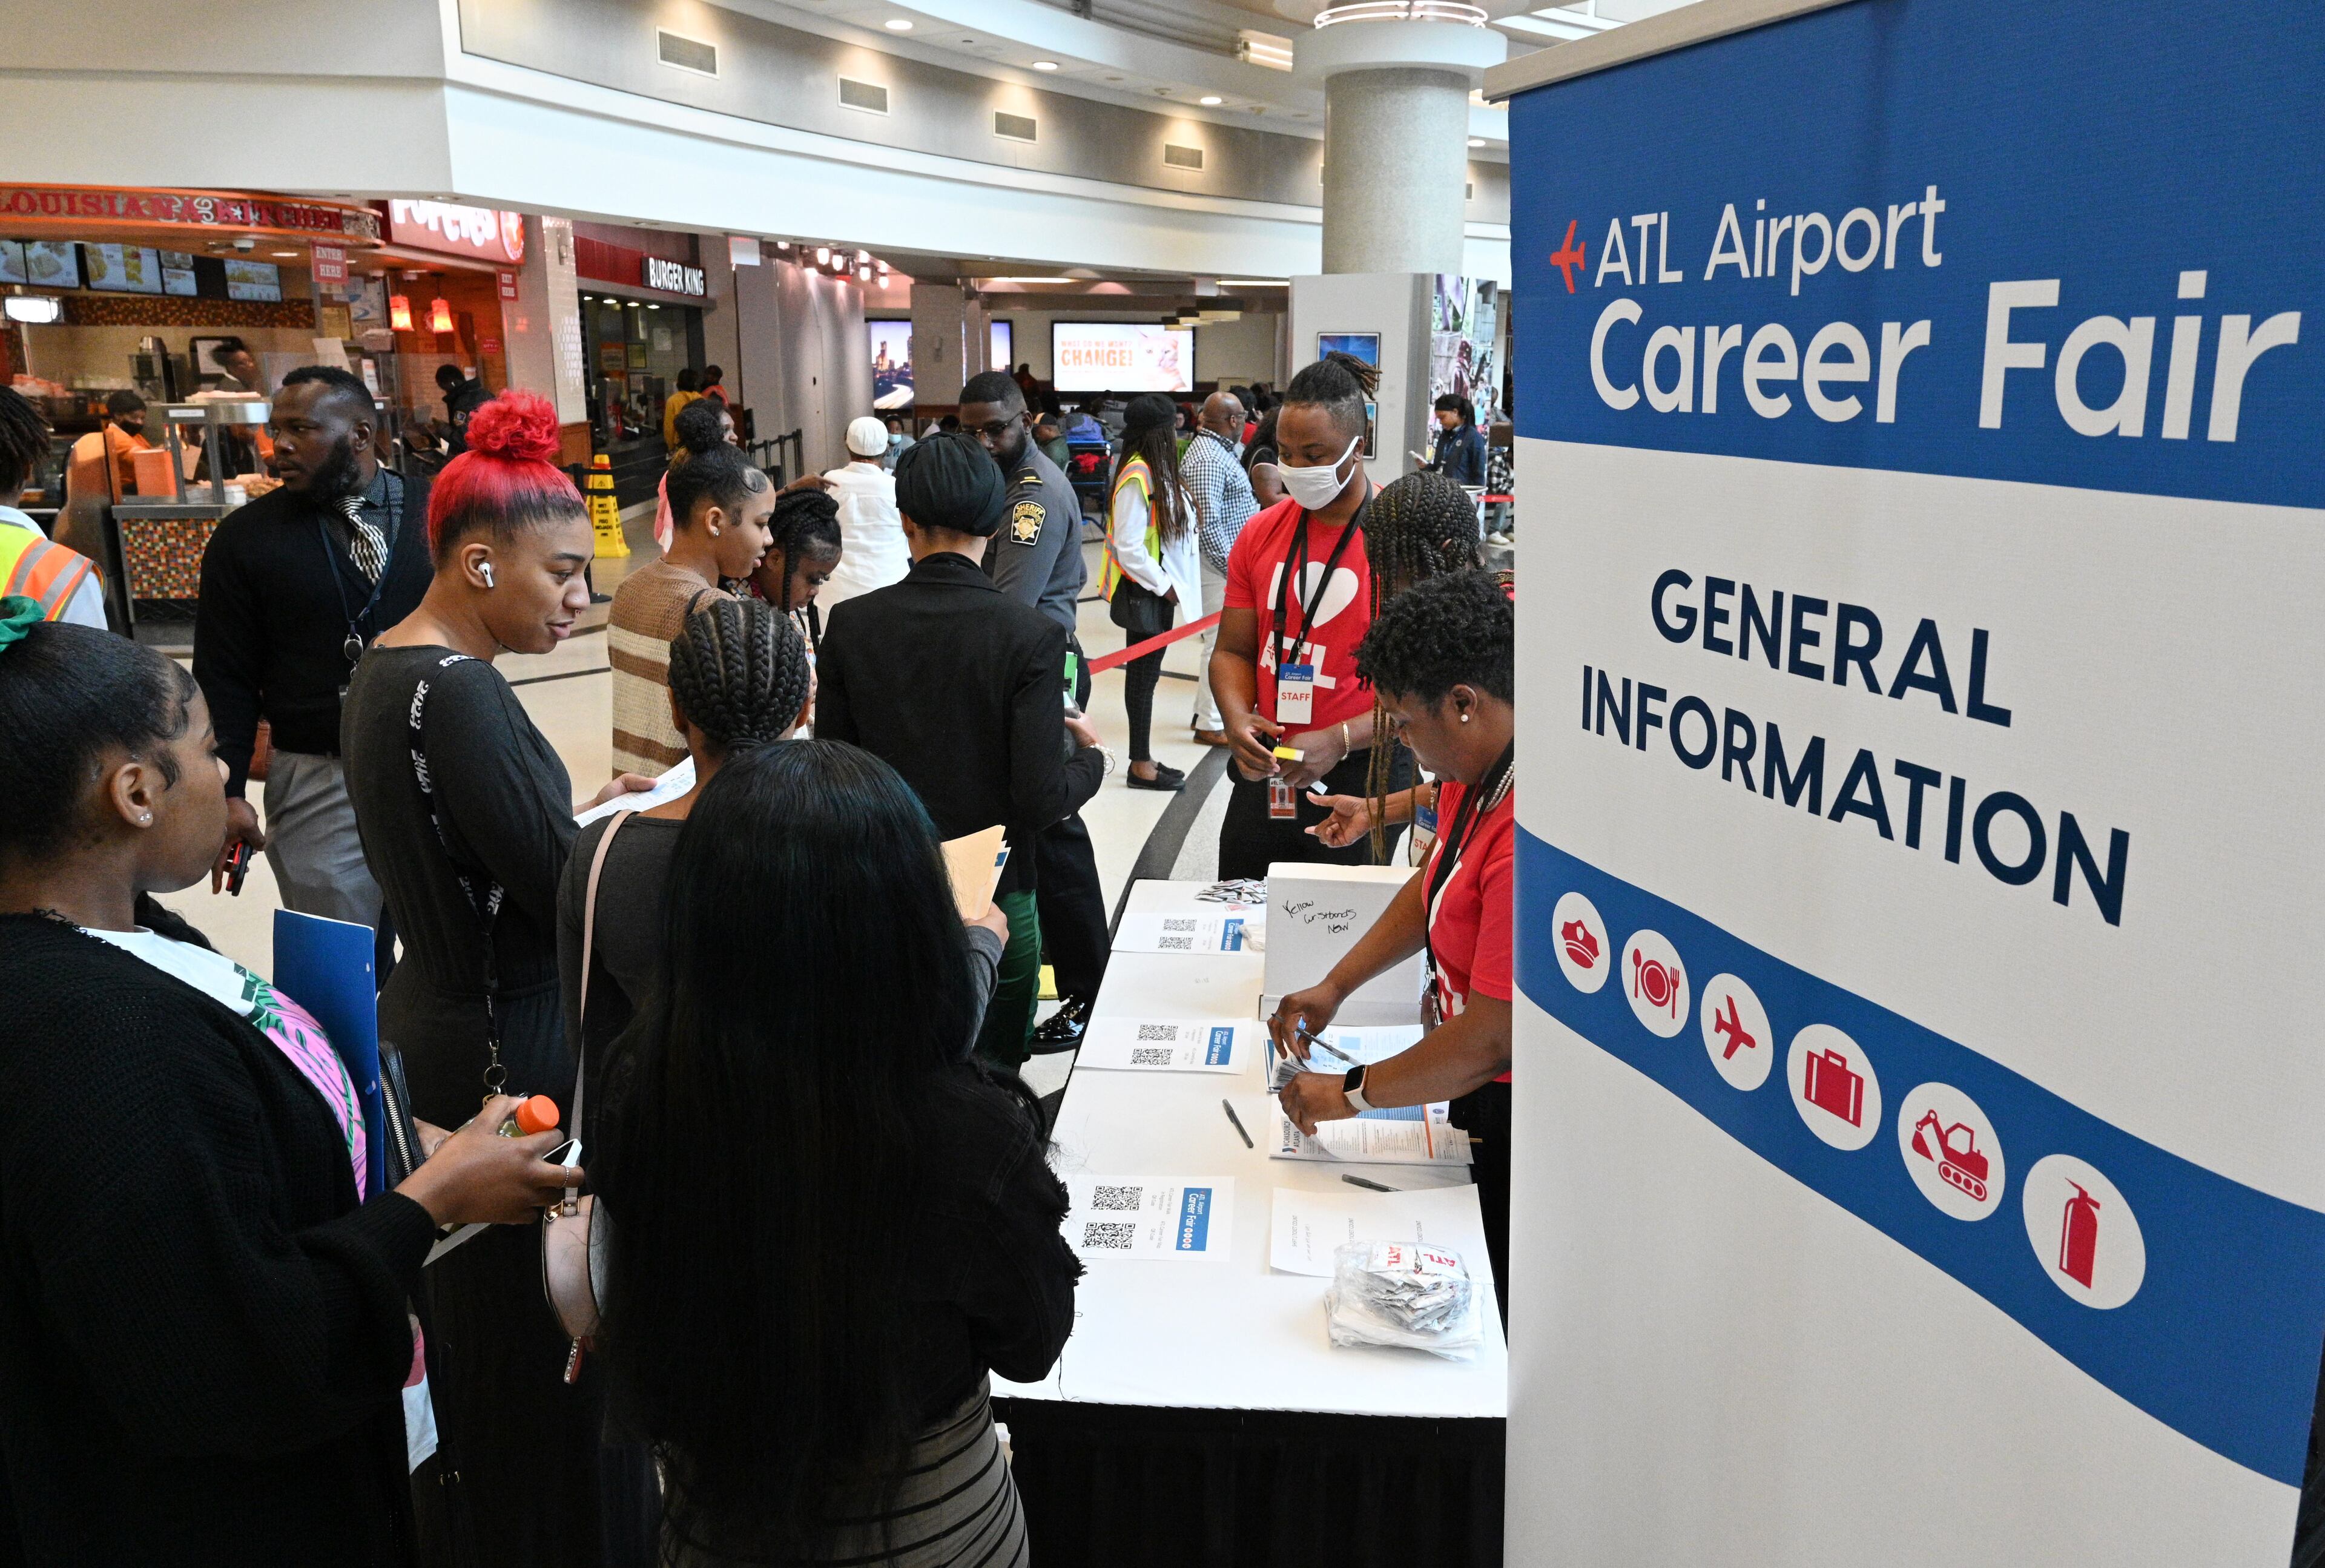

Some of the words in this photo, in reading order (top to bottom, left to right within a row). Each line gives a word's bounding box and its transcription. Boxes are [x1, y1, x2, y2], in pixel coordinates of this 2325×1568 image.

[1595, 212, 1683, 288] ATL
[1704, 185, 1945, 296] Airport
[315, 246, 343, 261] ENTER
[320, 264, 342, 277] HERE
[649, 257, 684, 292] BURGER
[685, 266, 704, 295] KING
[1061, 349, 1133, 366] CHANGE!
[1590, 298, 1931, 423] Career
[1979, 270, 2301, 442] Fair
[1015, 503, 1045, 515] SHERIFF
[1651, 568, 2013, 728] GENERAL
[1281, 692, 1311, 701] STAFF
[1581, 664, 2131, 927] INFORMATION
[1414, 838, 1428, 851] STA
[1282, 900, 1314, 918] Yellow
[1214, 1030, 1223, 1044] Career
[1212, 1044, 1222, 1053] Fair
[1187, 1193, 1199, 1214] Career
[1196, 1201, 1205, 1214] Airport
[1186, 1215, 1196, 1227] Fair
[1387, 1246, 1401, 1268] ATL
[1423, 1253, 1456, 1268] ATL
